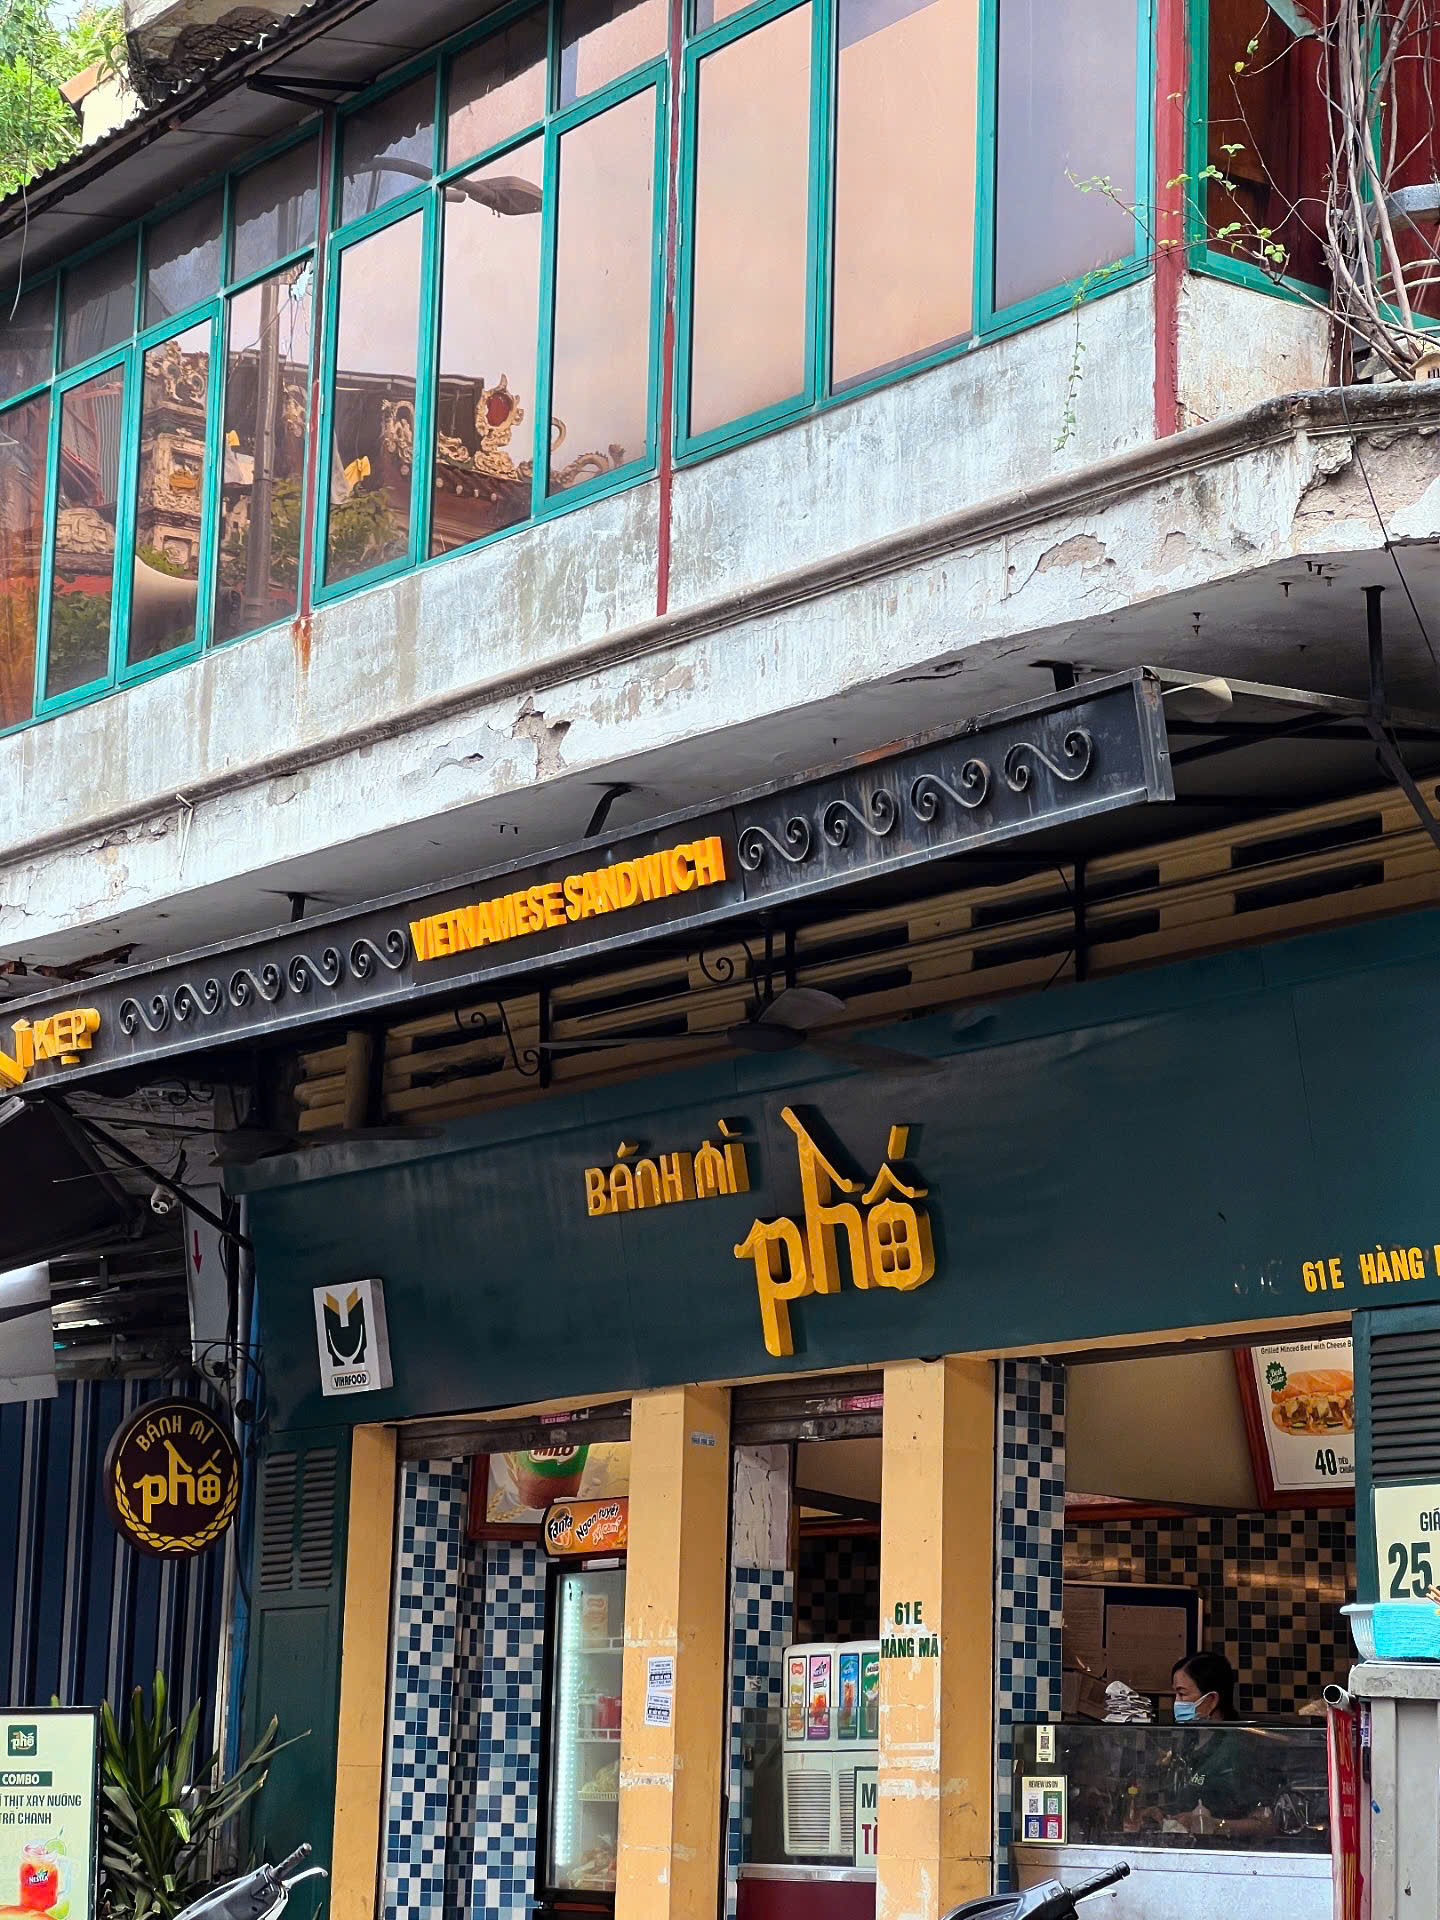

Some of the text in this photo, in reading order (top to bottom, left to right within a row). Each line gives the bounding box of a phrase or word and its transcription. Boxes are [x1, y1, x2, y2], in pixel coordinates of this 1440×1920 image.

[409, 836, 727, 962] VIETNAMESE SANDWICH
[585, 1118, 750, 1216] BÁNH MÌ
[734, 1106, 935, 1357] phố
[1359, 1244, 1426, 1285] HÀNG
[1280, 1344, 1299, 1353] Minced
[1300, 1343, 1313, 1351] Beef
[1313, 1341, 1326, 1350] with
[1326, 1340, 1346, 1349] Cheese
[136, 1415, 215, 1452] BÁNH MÌ
[1315, 1449, 1337, 1476] 40
[132, 1440, 222, 1524] phố
[547, 1513, 574, 1543] Fanta
[575, 1512, 598, 1543] Ngon
[880, 1633, 939, 1658] HÀNG MÃ
[1, 1774, 40, 1785] COMBO
[4, 1794, 24, 1809] THỊT
[26, 1795, 45, 1807] XAY
[17, 1812, 52, 1825] CHANH
